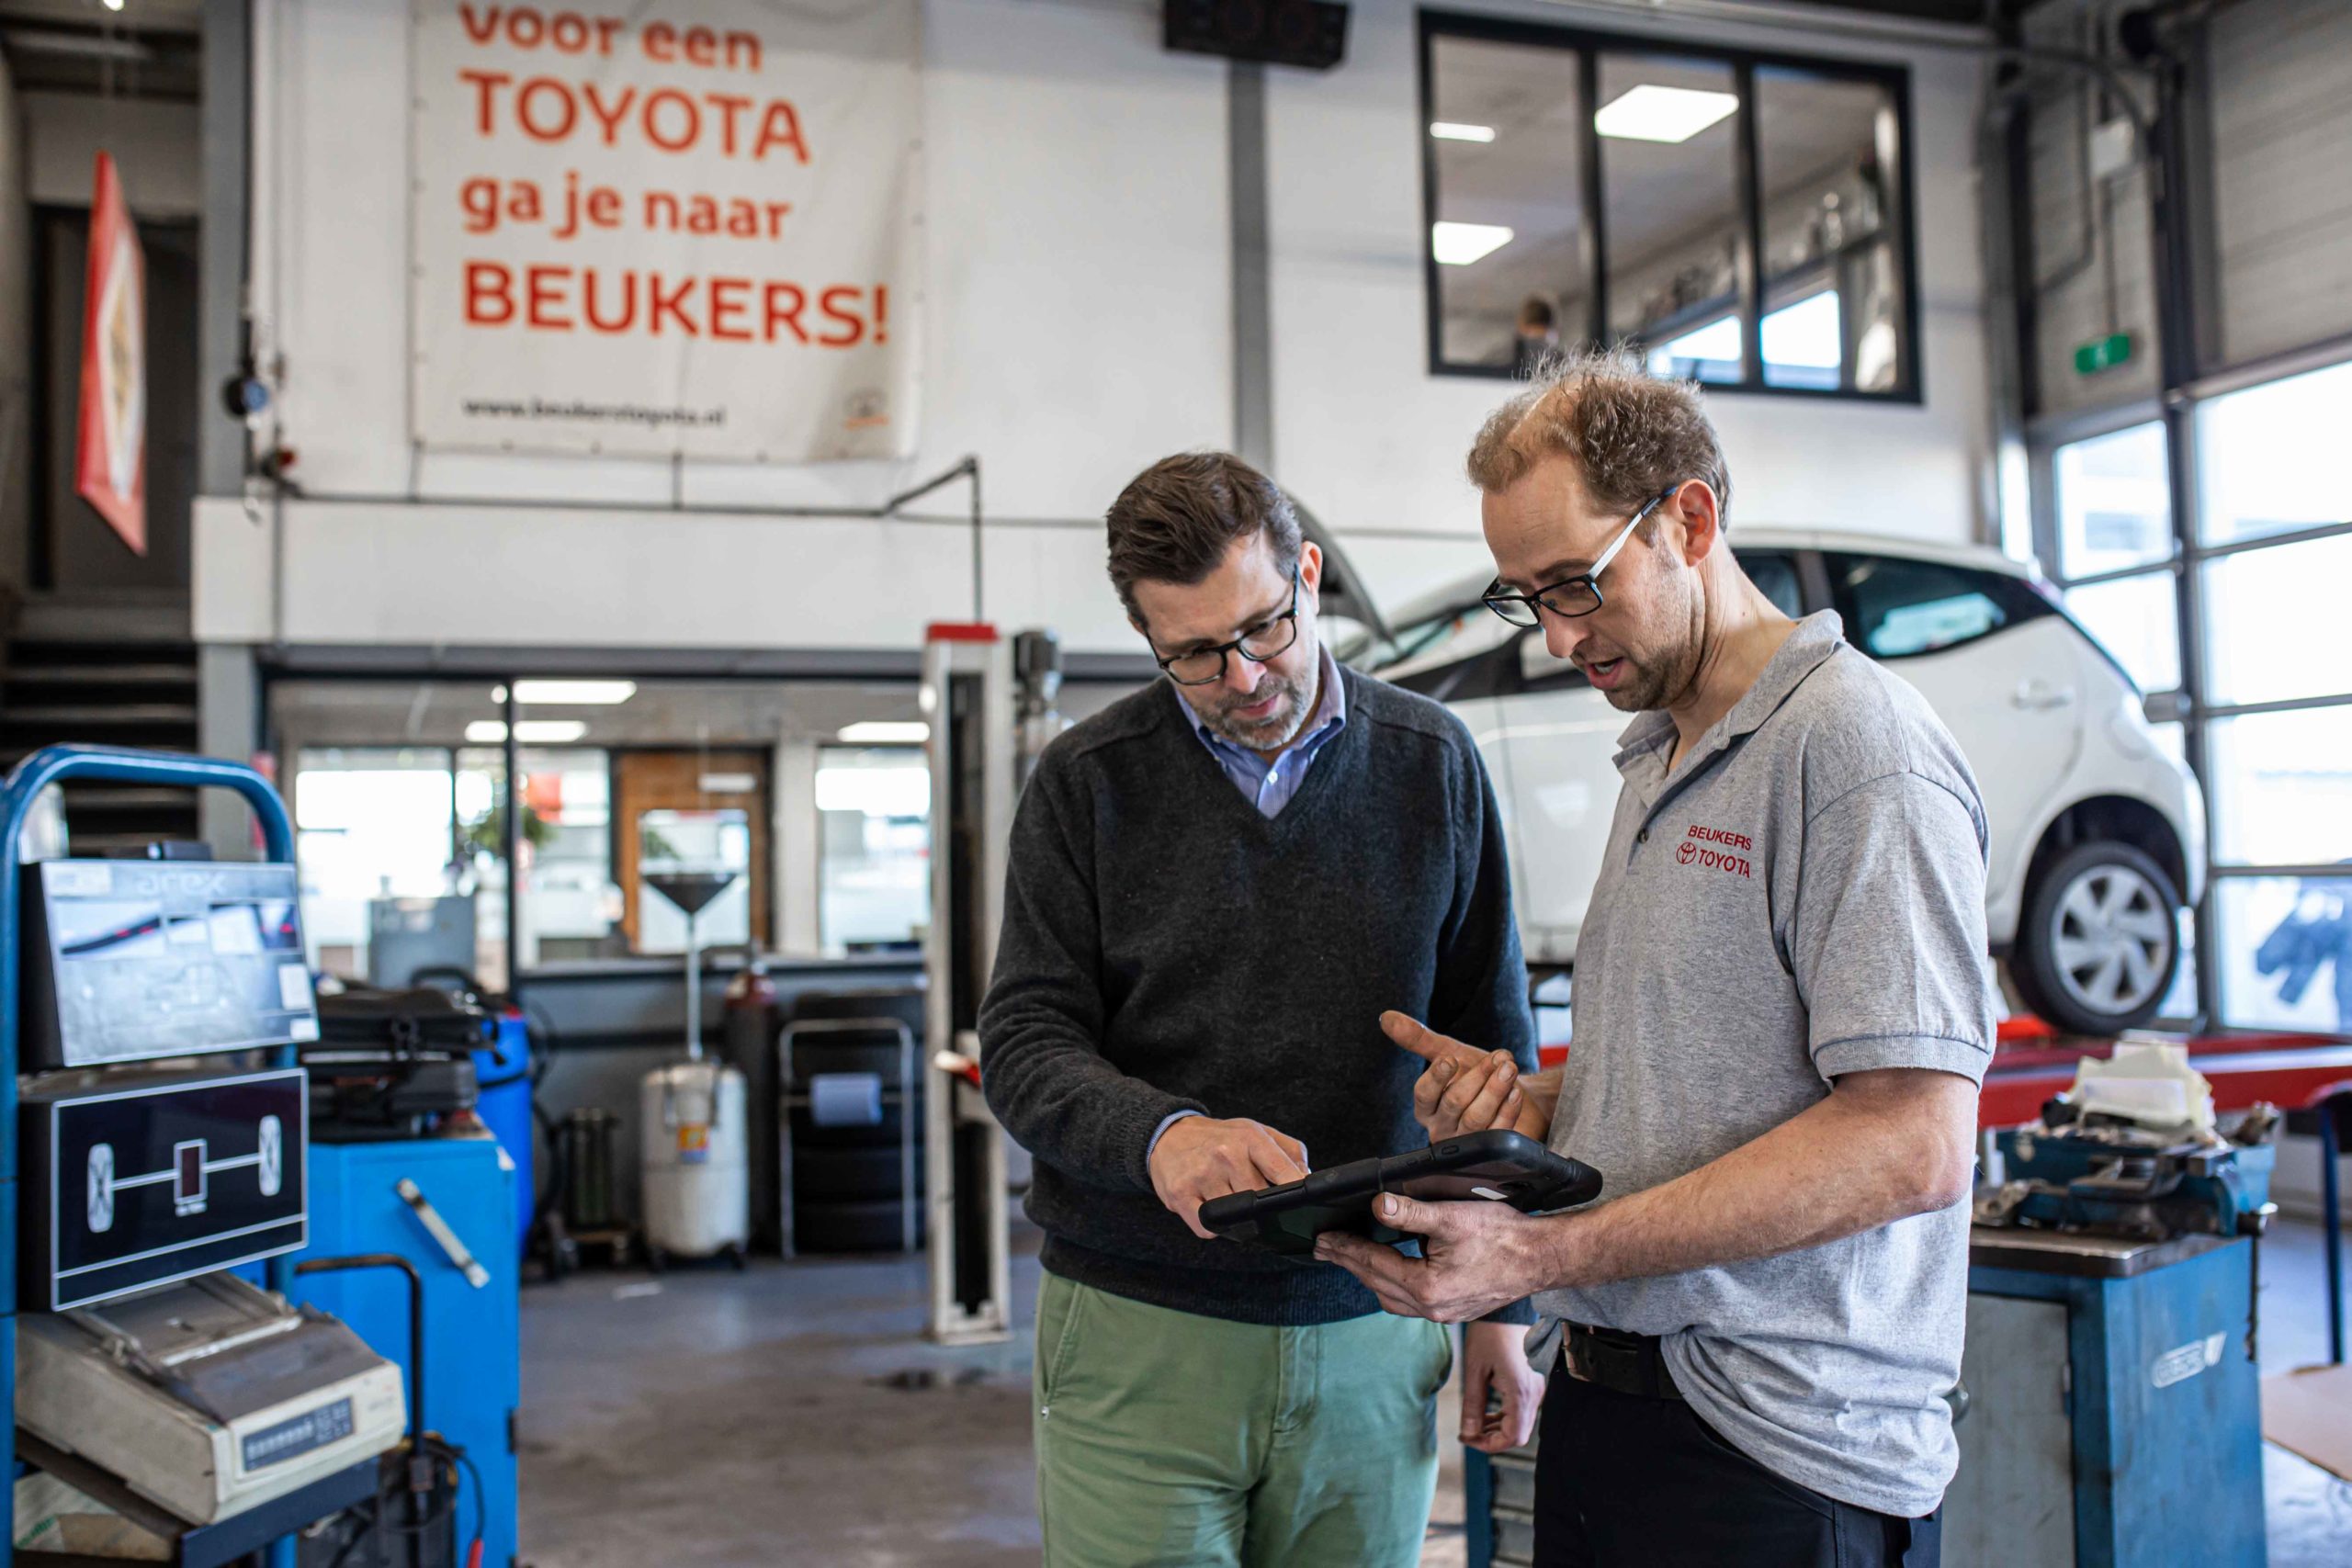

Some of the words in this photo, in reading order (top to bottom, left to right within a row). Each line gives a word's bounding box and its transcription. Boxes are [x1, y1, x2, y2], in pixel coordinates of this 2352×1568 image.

[458, 1, 624, 58] voor
[640, 20, 763, 73] een
[458, 68, 812, 165] TOYOTA
[458, 175, 544, 235] ga
[551, 170, 624, 241] je
[643, 190, 793, 241] naar
[462, 259, 890, 351] BEUKERS!
[1688, 825, 1752, 851] BEUKERS
[1698, 849, 1750, 878] TOYOTA
